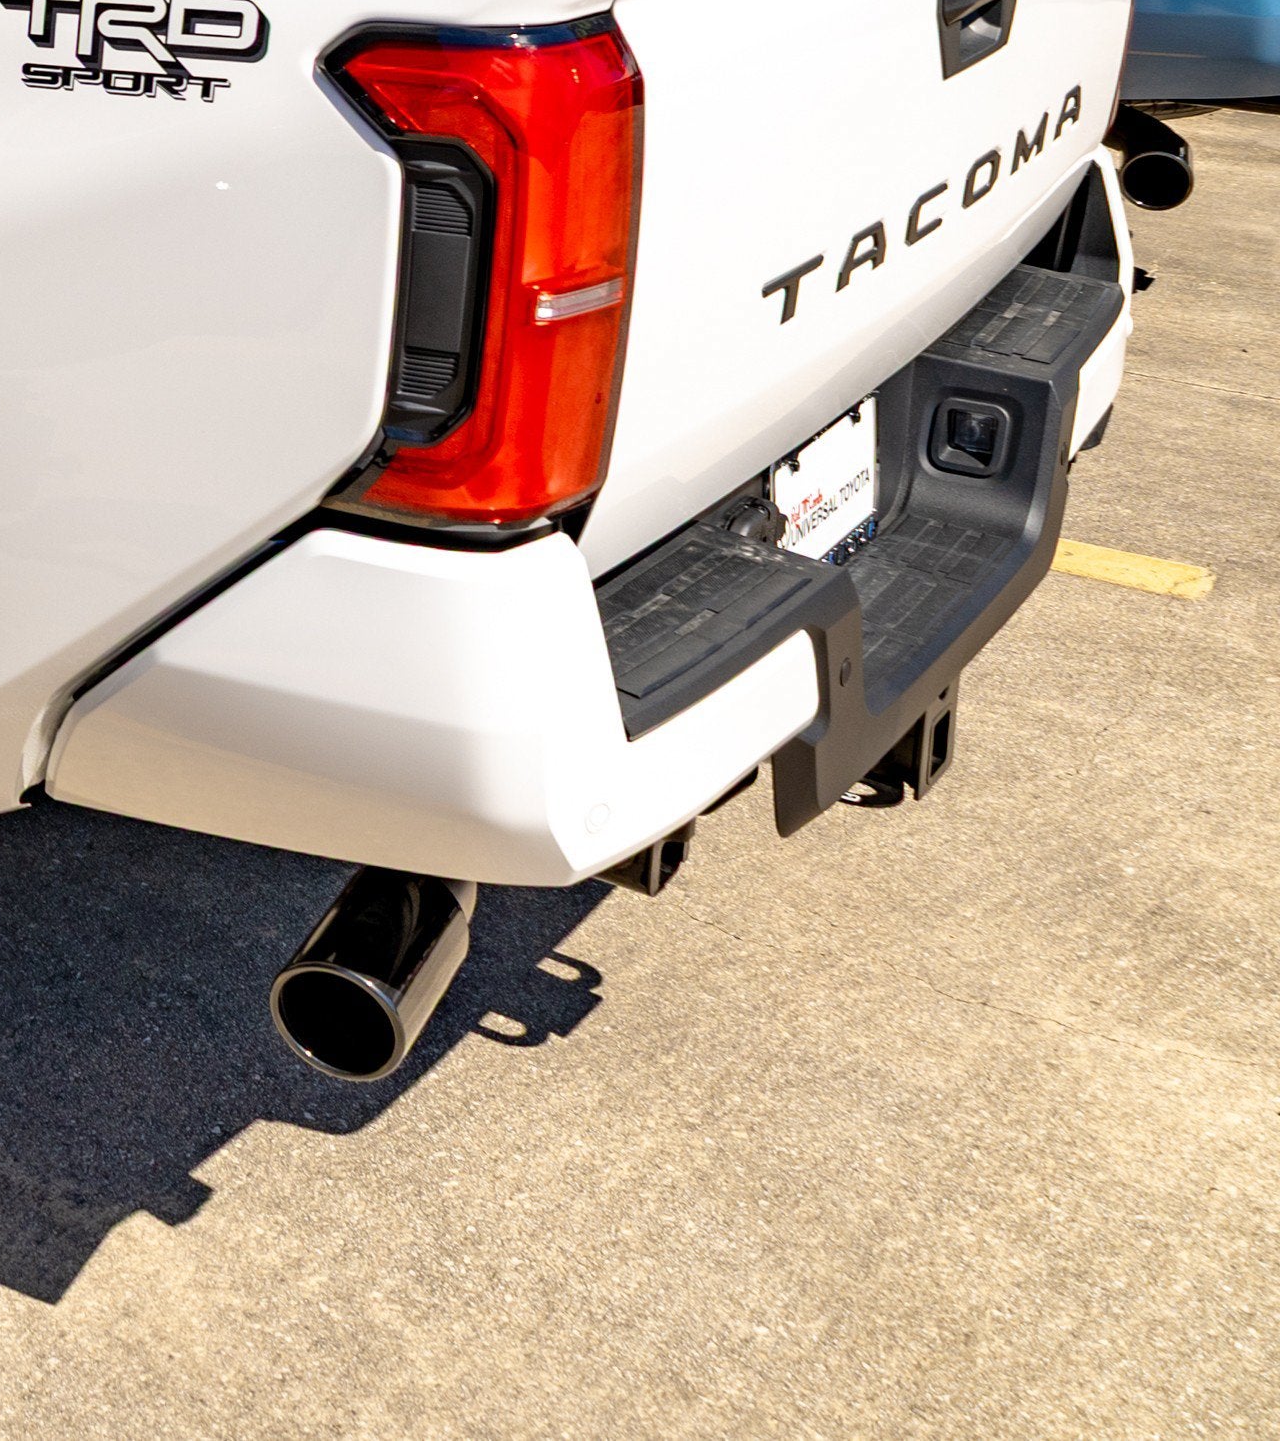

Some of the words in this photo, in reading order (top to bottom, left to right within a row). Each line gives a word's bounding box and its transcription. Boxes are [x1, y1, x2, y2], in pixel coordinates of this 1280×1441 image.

[21, 62, 231, 102] SPORT
[762, 85, 1081, 325] TACOMA
[790, 495, 838, 546] UNIVERSAL
[839, 467, 870, 506] TOYOTA
